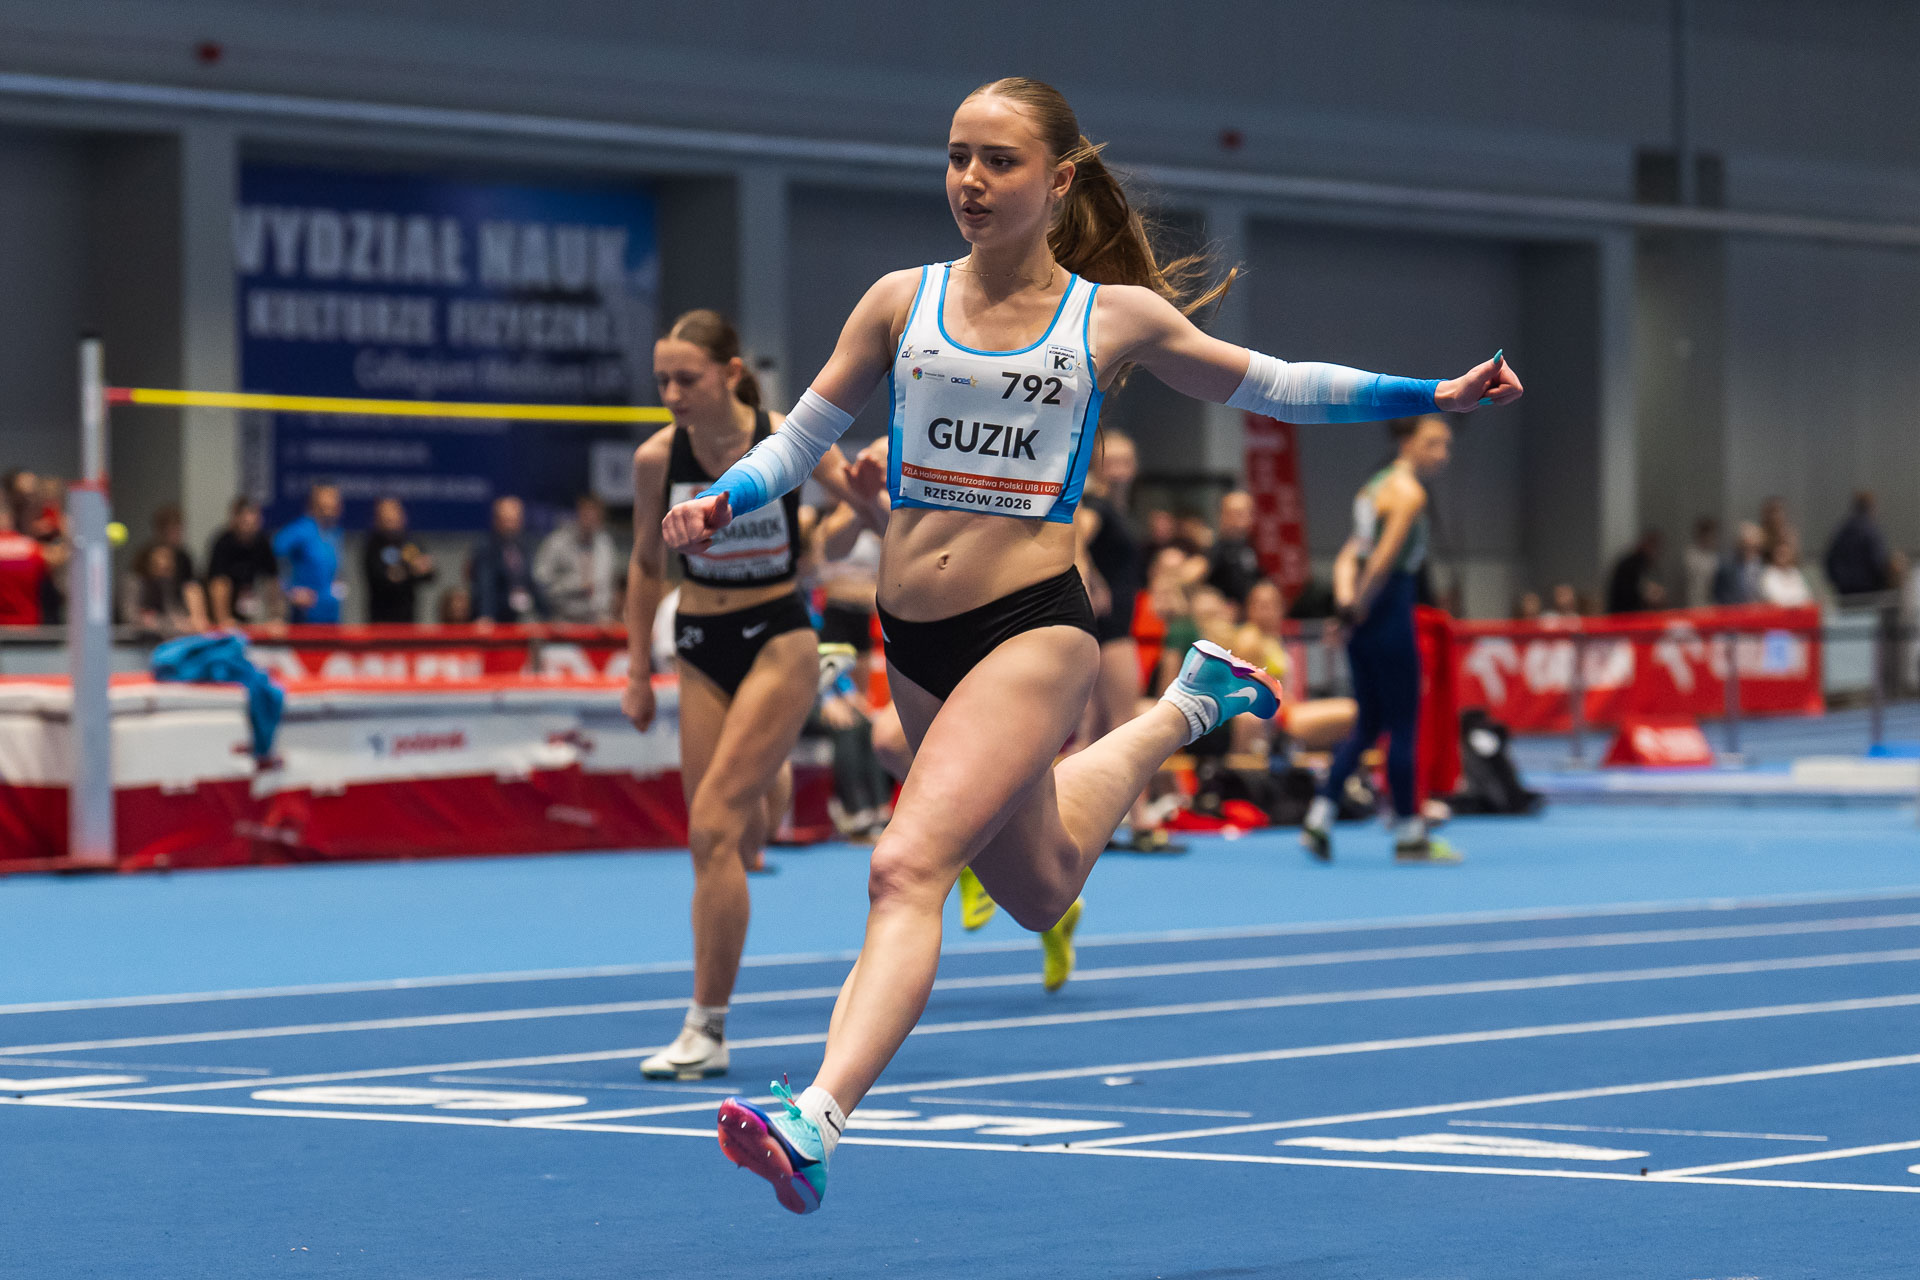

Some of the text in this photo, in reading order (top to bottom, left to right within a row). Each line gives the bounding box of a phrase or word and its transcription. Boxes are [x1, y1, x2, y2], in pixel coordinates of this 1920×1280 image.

[1001, 371, 1063, 405] 792
[927, 417, 1040, 461] GUZIK
[904, 466, 918, 475] PZLA
[920, 471, 947, 481] Halowe
[949, 475, 997, 488] Mistrzostwa
[999, 481, 1023, 491] Polski
[1025, 484, 1039, 492] U18
[1045, 485, 1060, 494] U20
[924, 486, 1032, 510] RZESZÓW 2026
[719, 517, 782, 543] MAREK
